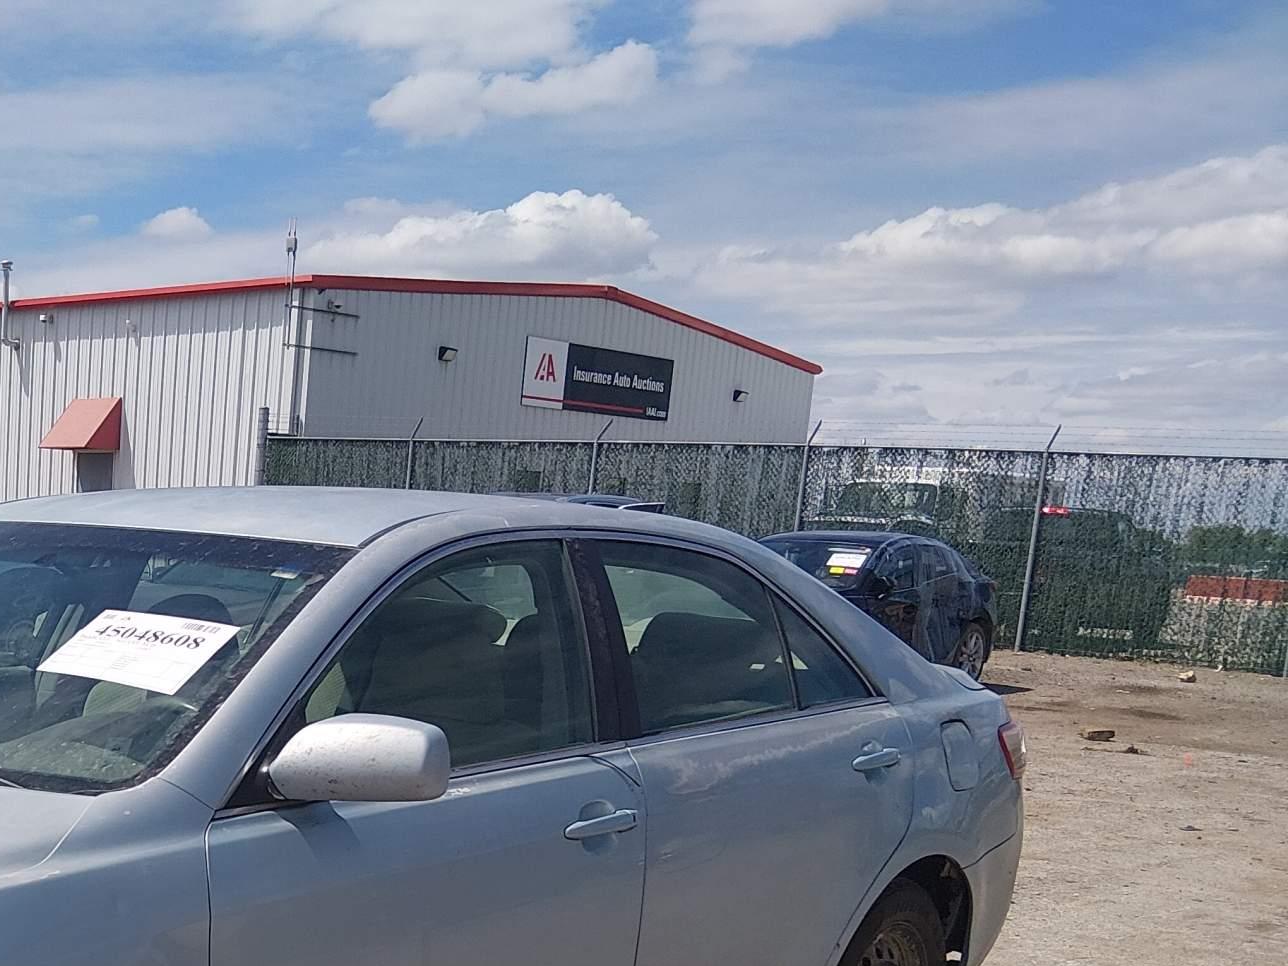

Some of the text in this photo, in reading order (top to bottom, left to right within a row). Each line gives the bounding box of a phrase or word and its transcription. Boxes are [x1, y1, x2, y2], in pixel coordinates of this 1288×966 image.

[573, 365, 665, 394] Insurance Auto Auctions
[95, 624, 207, 650] 45048608
